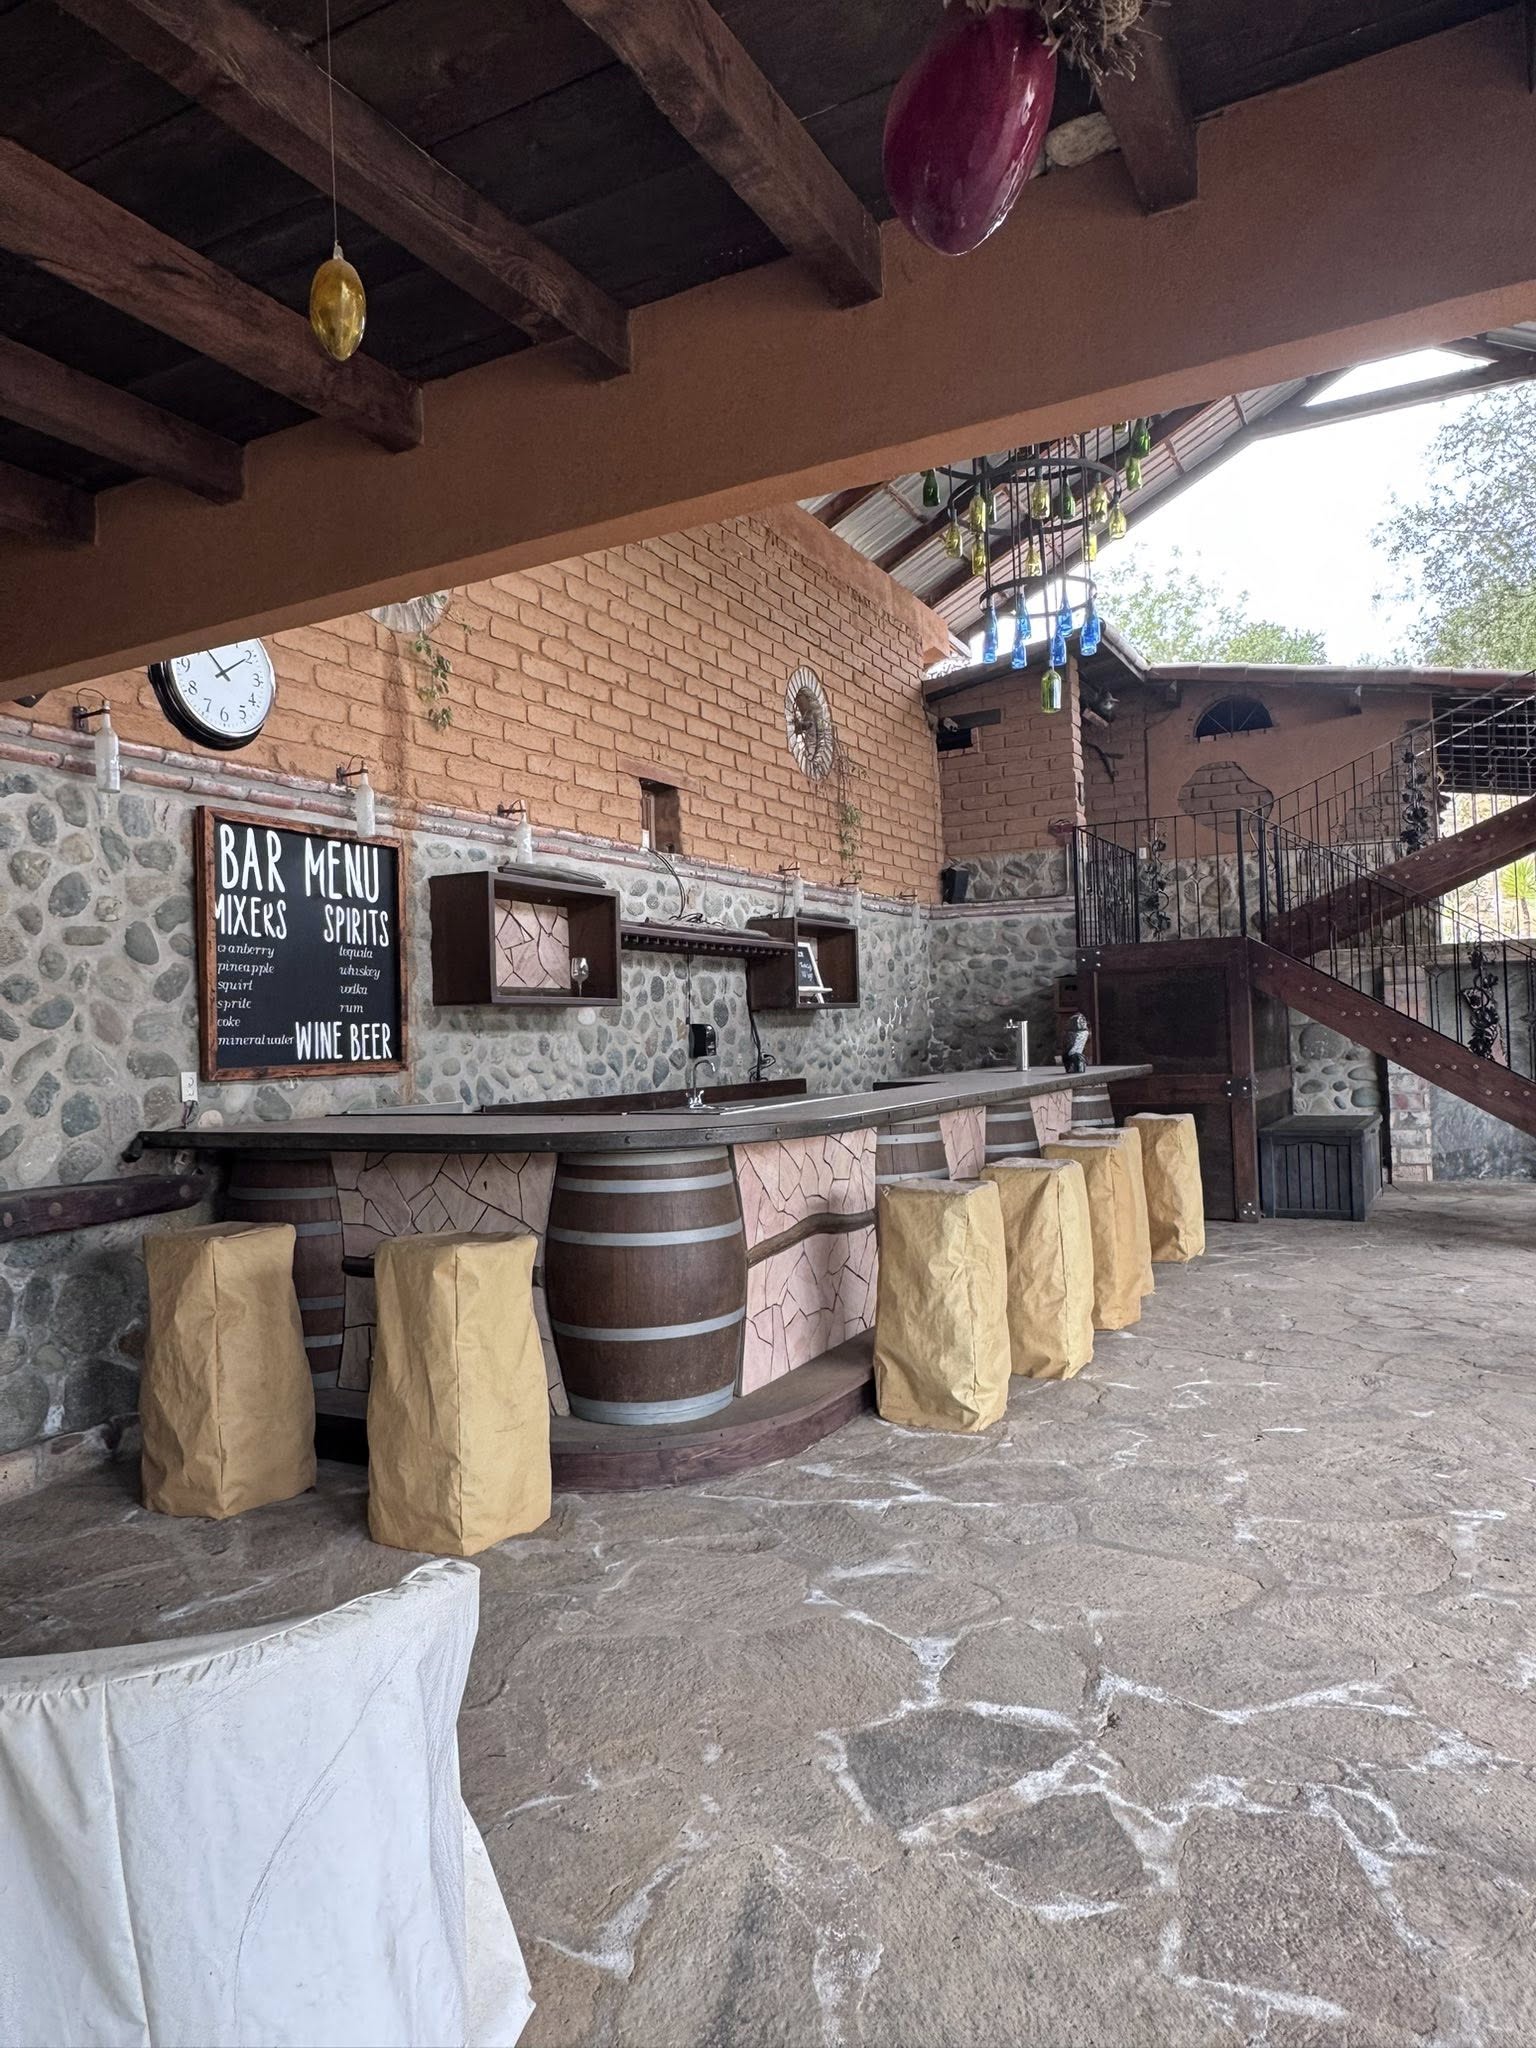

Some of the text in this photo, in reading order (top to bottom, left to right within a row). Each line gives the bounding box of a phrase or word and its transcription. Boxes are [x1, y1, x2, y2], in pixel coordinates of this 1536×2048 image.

[245, 650, 254, 664] 2
[181, 658, 190, 672] 9
[188, 680, 198, 695] 8
[253, 673, 261, 687] 3
[203, 698, 212, 712] 7
[248, 692, 256, 706] 4
[220, 707, 229, 721] 6
[239, 705, 247, 720] 5
[220, 824, 379, 903] BAR MENU
[215, 893, 287, 939] MIXERS
[324, 904, 389, 947] SPIRITS
[217, 943, 275, 959] cranberry
[339, 945, 373, 960] tequila
[217, 960, 275, 976] pineapple
[340, 964, 381, 980] whiskey
[217, 979, 253, 993] squirt
[340, 983, 368, 995] vodka
[216, 997, 252, 1012] sprite
[340, 1004, 363, 1013] rum
[217, 1015, 241, 1027] coke
[295, 1021, 392, 1061] WINE BEER
